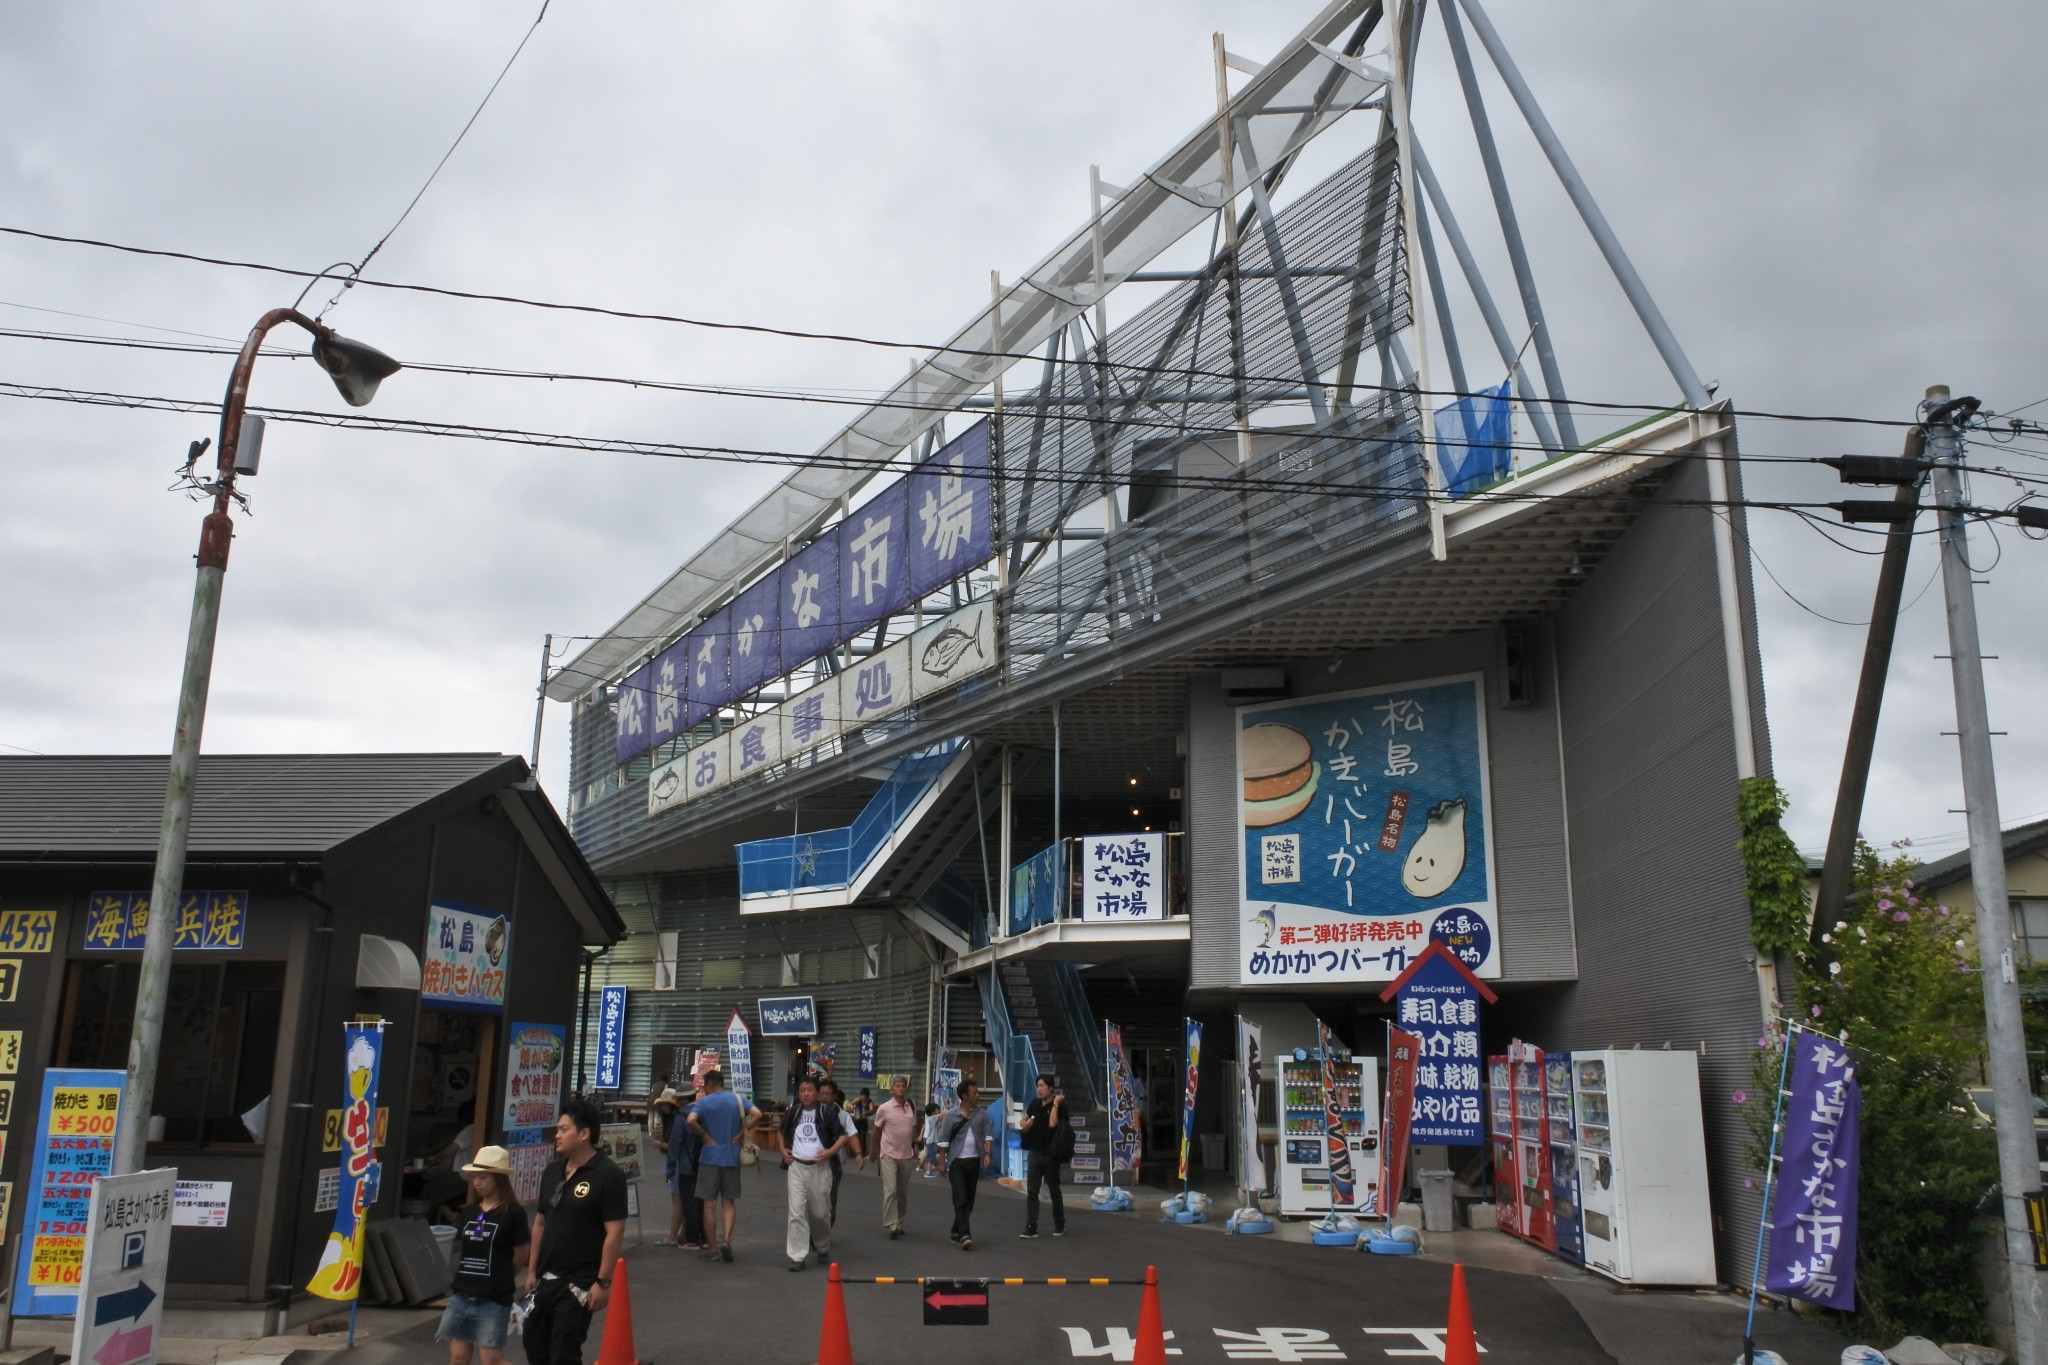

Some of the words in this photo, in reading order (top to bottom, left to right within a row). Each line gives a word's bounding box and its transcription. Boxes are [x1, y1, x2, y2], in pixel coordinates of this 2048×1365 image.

[618, 452, 974, 736] 松島さかな市場
[694, 660, 893, 788] お食事処
[1373, 699, 1424, 777] 松島
[1323, 717, 1371, 907] かきバーガー
[1382, 795, 1407, 849] 松島名物
[1094, 838, 1151, 867] 松島
[1266, 838, 1295, 853] 松島
[1266, 852, 1295, 865] さかな
[1094, 865, 1151, 888] さかな
[1267, 866, 1294, 880] 市場
[1096, 891, 1148, 917] 市場
[439, 915, 475, 954] 松島
[1279, 920, 1424, 945] 第二弾好評発売中
[1435, 915, 1484, 934] 松島の
[1449, 935, 1474, 945] NEW
[422, 958, 505, 998] 焼がきハウス
[601, 990, 621, 1085] 松島さかな市場
[54, 1093, 89, 1110] 焼がき
[97, 1094, 118, 1111] 3個
[49, 1138, 99, 1150] 五大堂A
[103, 1189, 169, 1233] 松島さかな市場
[123, 1233, 145, 1268] P
